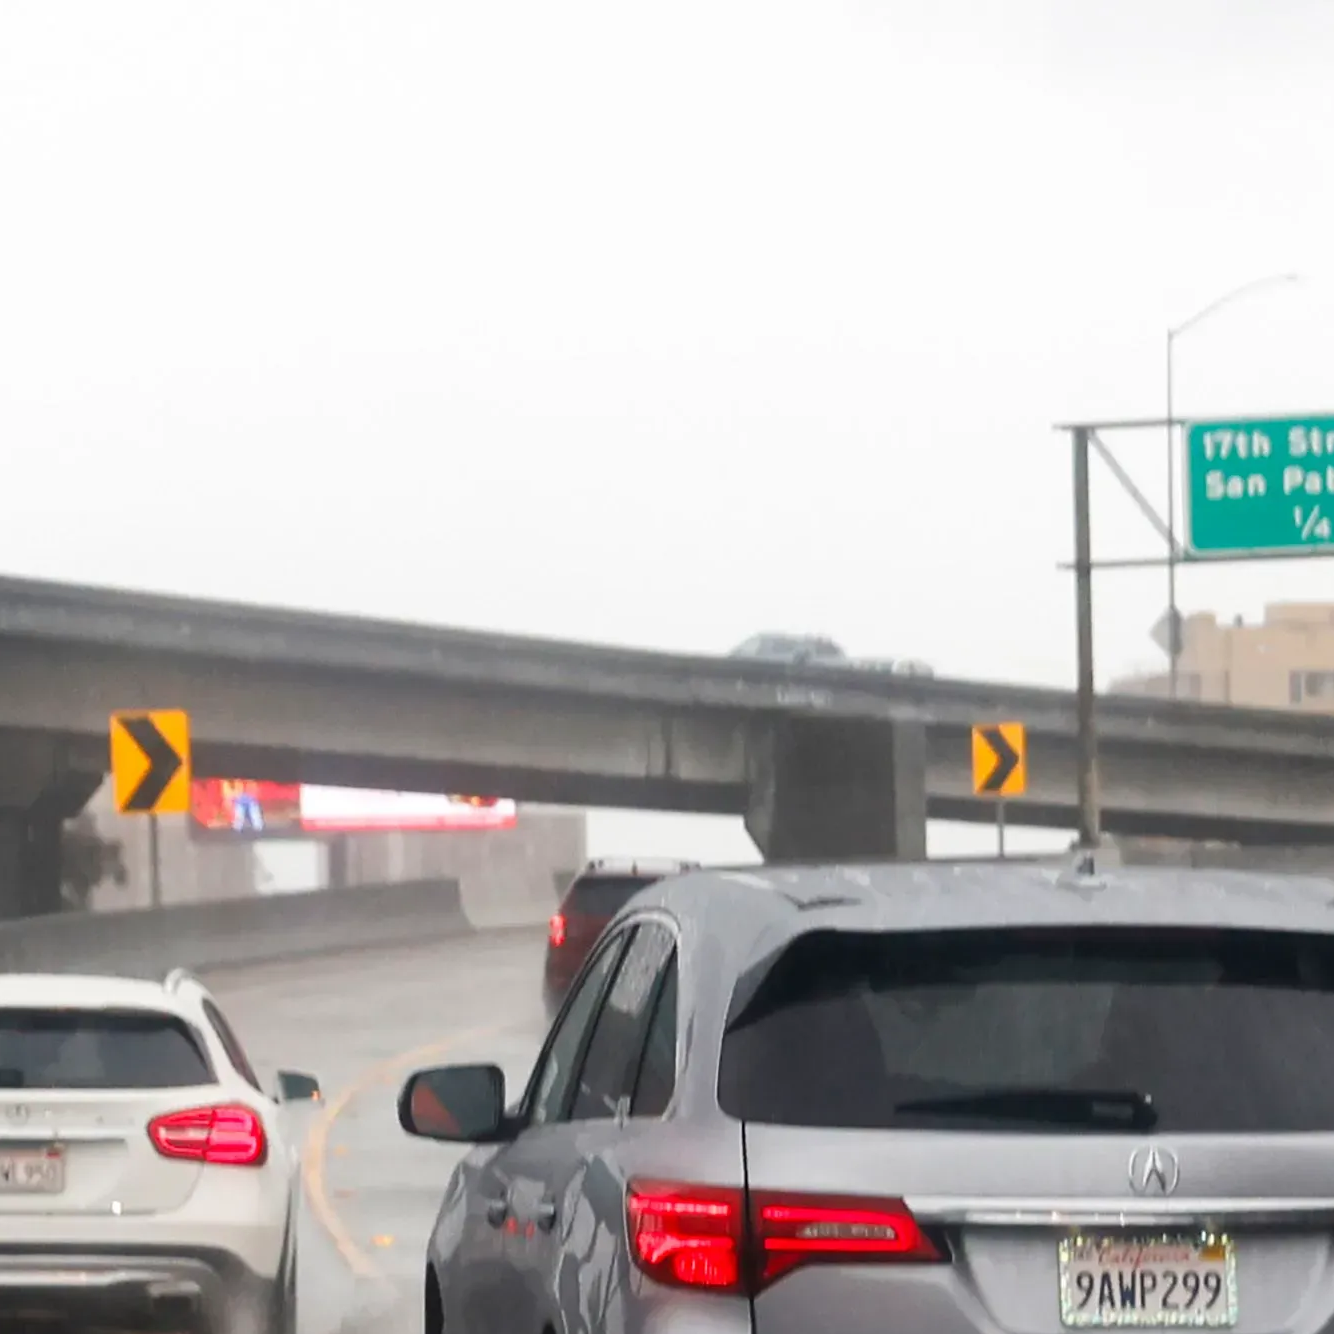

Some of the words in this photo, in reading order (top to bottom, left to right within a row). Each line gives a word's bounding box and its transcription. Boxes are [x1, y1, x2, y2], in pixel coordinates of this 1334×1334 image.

[1203, 429, 1272, 461] 17th
[1204, 469, 1268, 501] San
[1075, 1268, 1223, 1312] 9AWP299
